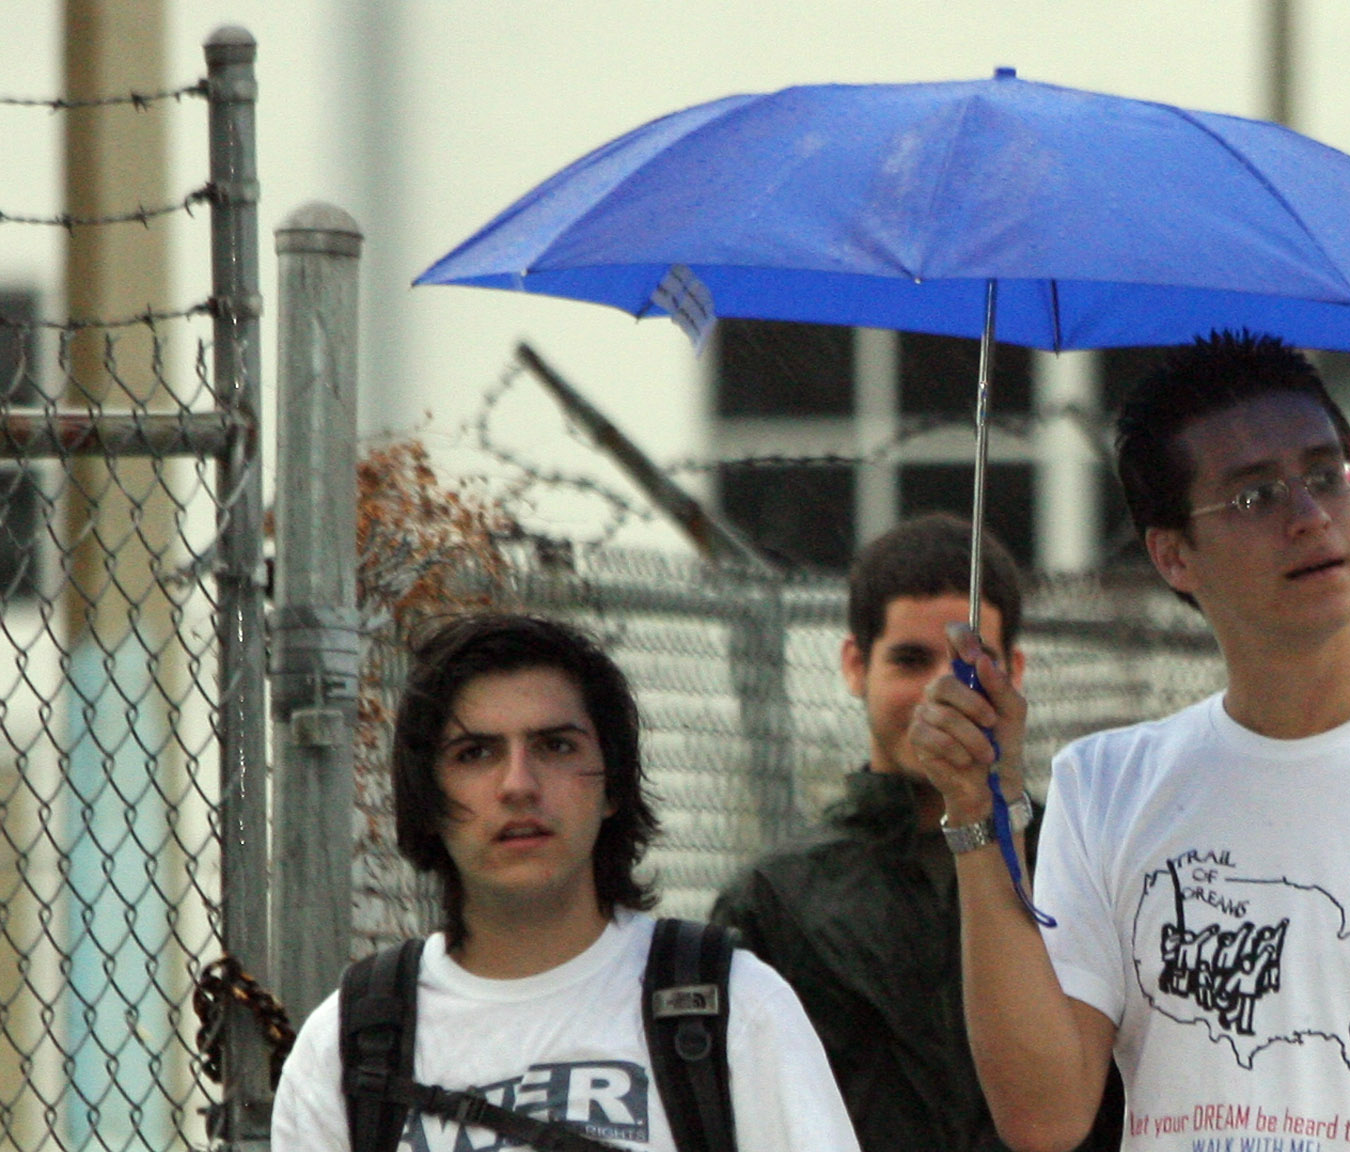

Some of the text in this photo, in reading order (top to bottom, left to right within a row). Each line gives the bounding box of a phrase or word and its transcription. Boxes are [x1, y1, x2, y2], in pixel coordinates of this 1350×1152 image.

[1173, 849, 1236, 868] TRAIL
[1192, 867, 1218, 884] OF
[1154, 1115, 1189, 1138] your
[1193, 1103, 1251, 1132] DREAM
[1256, 1105, 1278, 1133] be
[1283, 1106, 1339, 1141] heard
